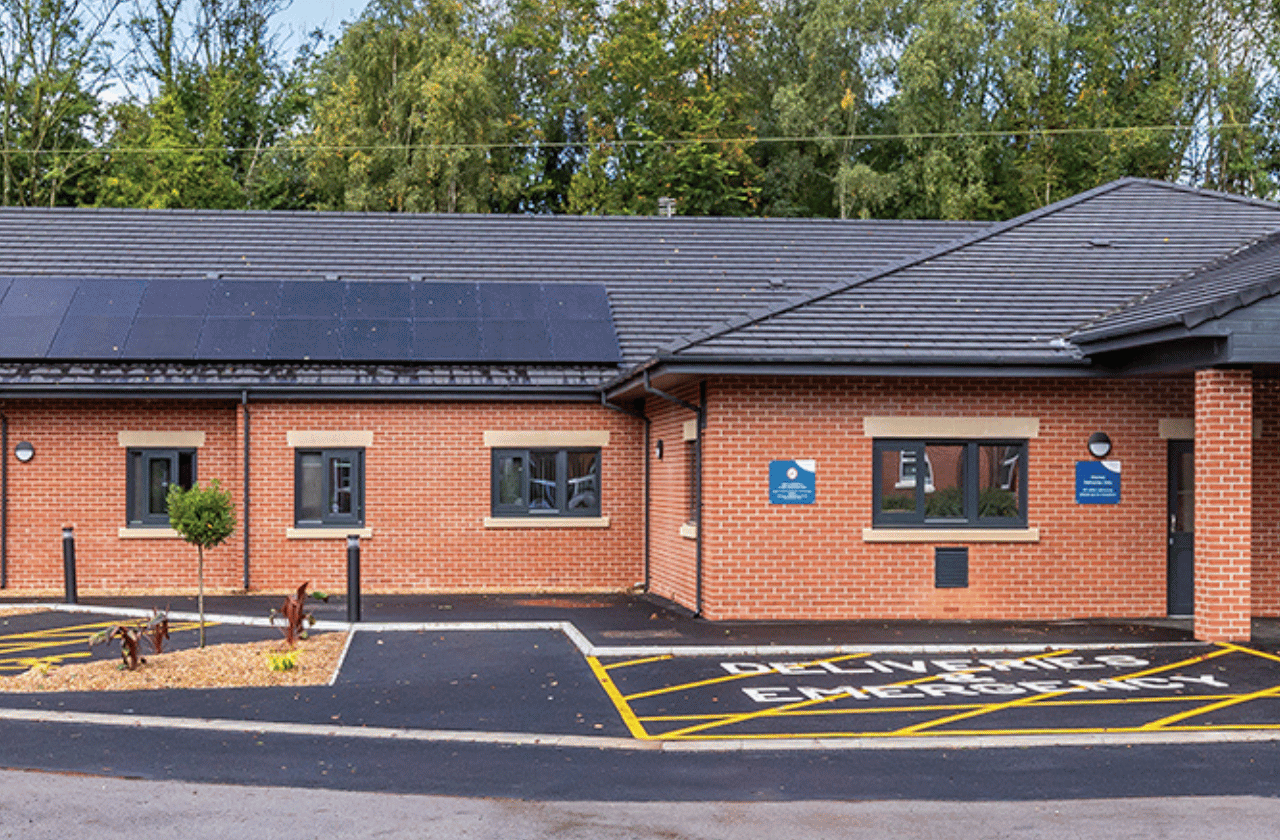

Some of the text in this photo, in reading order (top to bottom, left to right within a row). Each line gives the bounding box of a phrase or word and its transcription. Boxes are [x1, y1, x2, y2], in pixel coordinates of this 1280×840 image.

[720, 655, 1149, 675] DELIVERIES
[937, 673, 997, 683] &
[742, 675, 1229, 702] EMERGENCY
